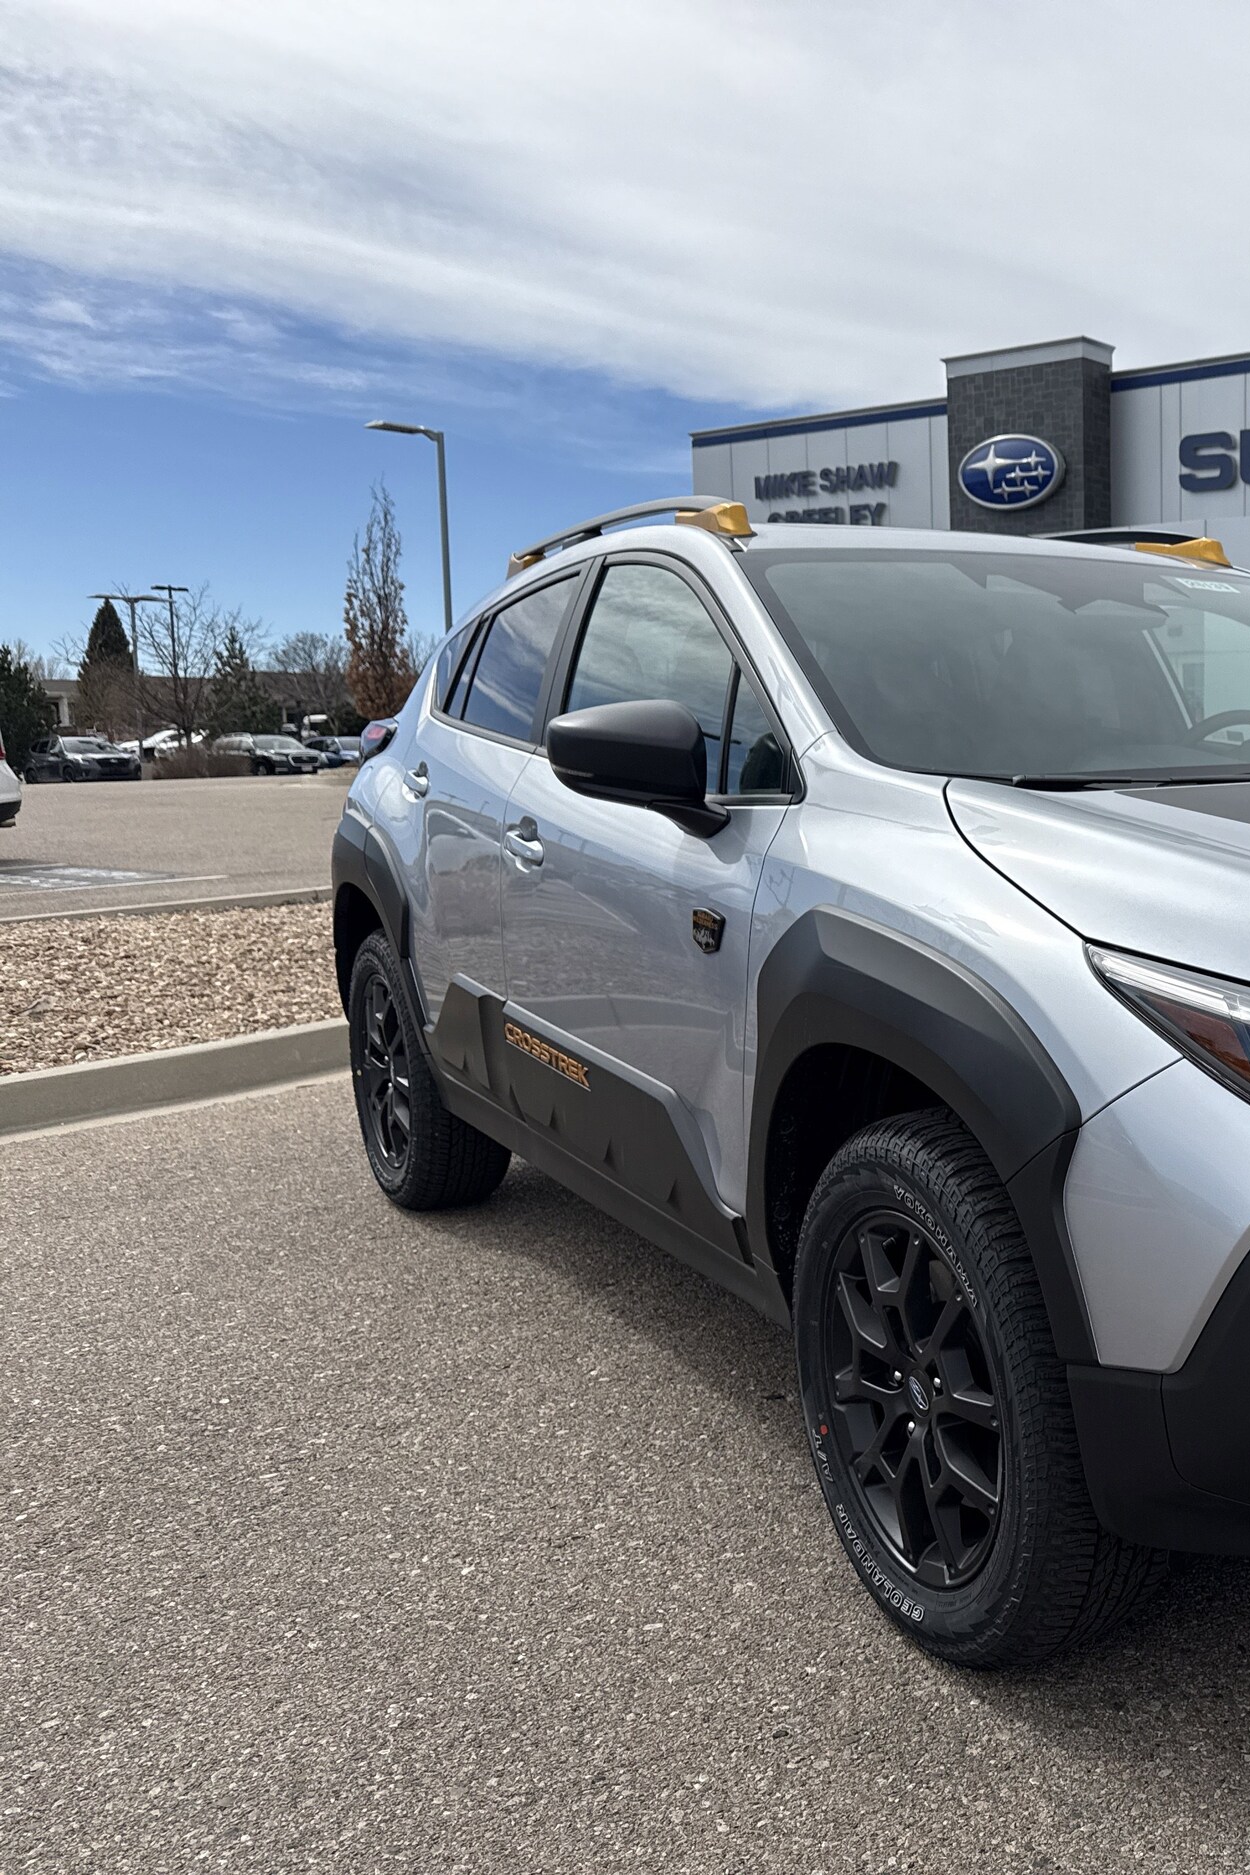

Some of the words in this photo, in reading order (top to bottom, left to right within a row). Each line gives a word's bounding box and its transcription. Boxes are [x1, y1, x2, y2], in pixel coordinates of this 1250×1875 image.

[755, 470, 817, 501] MIKE
[820, 461, 898, 494] SHAW
[504, 1023, 589, 1087] CROSSTREK
[894, 1184, 977, 1307] YOKOHAMA
[835, 1503, 925, 1621] GEOLANDAR
